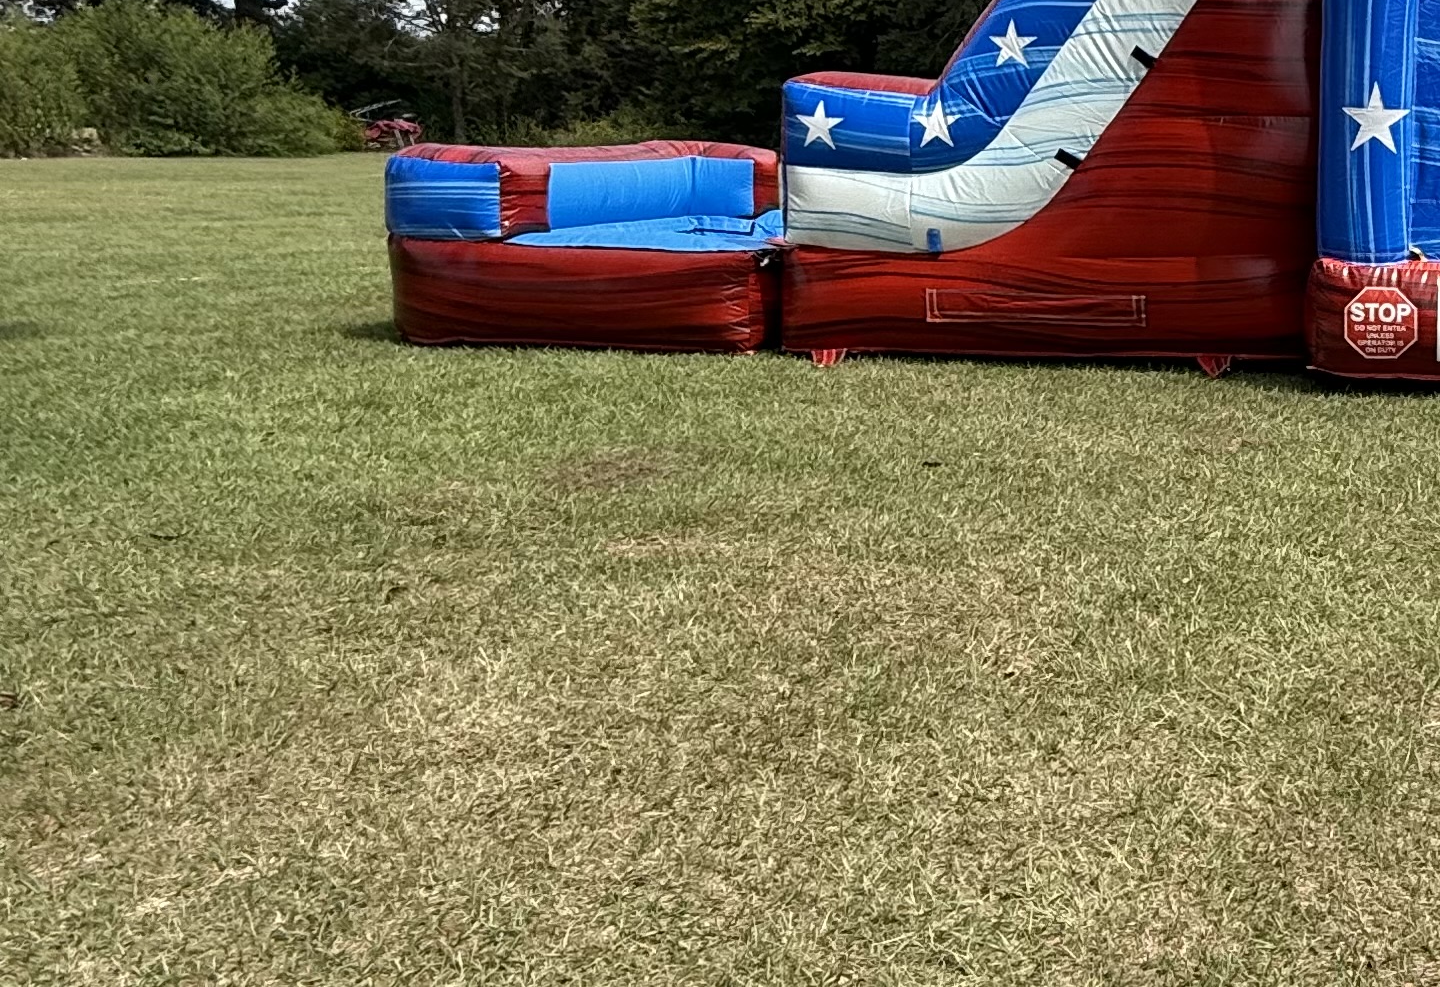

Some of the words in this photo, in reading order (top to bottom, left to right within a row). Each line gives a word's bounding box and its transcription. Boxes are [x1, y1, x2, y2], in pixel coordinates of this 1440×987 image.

[1350, 302, 1411, 323] STOP
[1354, 324, 1366, 332] DO
[1366, 324, 1381, 332] NOT
[1382, 324, 1407, 332] ENTER
